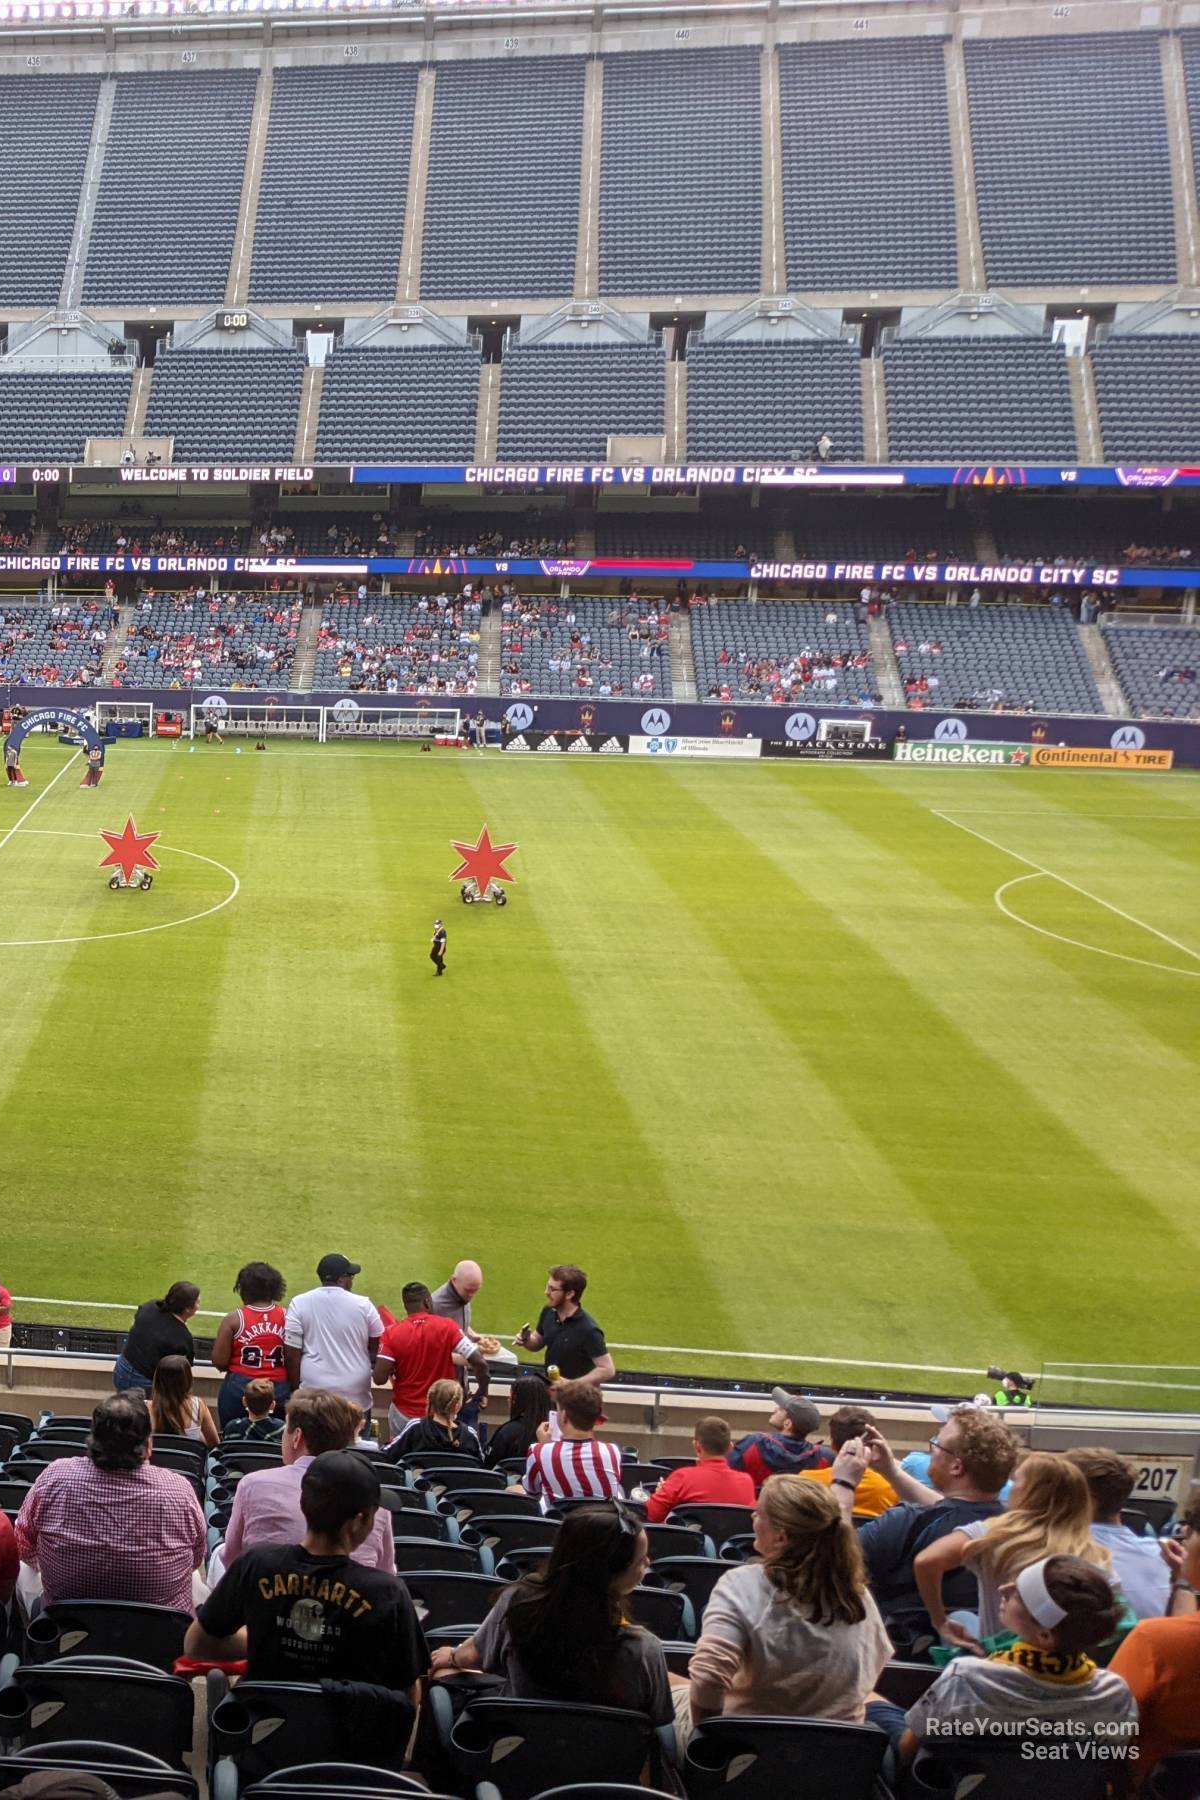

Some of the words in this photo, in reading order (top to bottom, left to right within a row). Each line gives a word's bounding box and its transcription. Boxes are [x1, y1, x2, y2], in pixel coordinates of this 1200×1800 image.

[1053, 6, 1072, 18] 442
[853, 20, 869, 30] 441
[675, 29, 690, 40] 440
[504, 38, 519, 48] 439
[344, 44, 359, 56] 438
[26, 56, 41, 66] 436
[182, 52, 197, 62] 437
[224, 314, 247, 326] 0:00
[2, 470, 10, 481] 0
[32, 470, 60, 482] 0:00
[120, 468, 186, 481] WELCOME
[191, 468, 209, 481] TO
[214, 468, 271, 481] SOLDIER
[274, 468, 314, 480] FIELD
[466, 468, 539, 482] CHICAGO
[546, 468, 584, 482] FIRE
[591, 468, 614, 482] FC
[621, 468, 645, 482] VS
[651, 468, 735, 482] ORLANDO
[1060, 472, 1077, 481] VS
[67, 558, 100, 570] FIRE
[106, 558, 124, 570] FC
[131, 558, 151, 570] VS
[158, 558, 228, 571] ORLANDO
[496, 563, 508, 572] VS
[751, 564, 827, 578] CHICAGO
[834, 564, 874, 580] FIRE
[882, 565, 905, 580] FC
[913, 566, 938, 581] VS
[944, 566, 1032, 583] ORLANDO
[1040, 568, 1085, 584] CITY
[1092, 570, 1119, 584] SC
[22, 711, 56, 730] CHICAGO
[58, 712, 77, 724] FIRE
[77, 720, 88, 732] FC
[785, 740, 886, 750] BLACKSTONE
[895, 740, 1004, 764] Heineken
[1036, 748, 1118, 765] Continental
[1134, 754, 1166, 765] TIRE
[241, 1345, 284, 1368] 24
[1137, 1467, 1178, 1491] 207
[258, 1573, 372, 1618] CARHARTT
